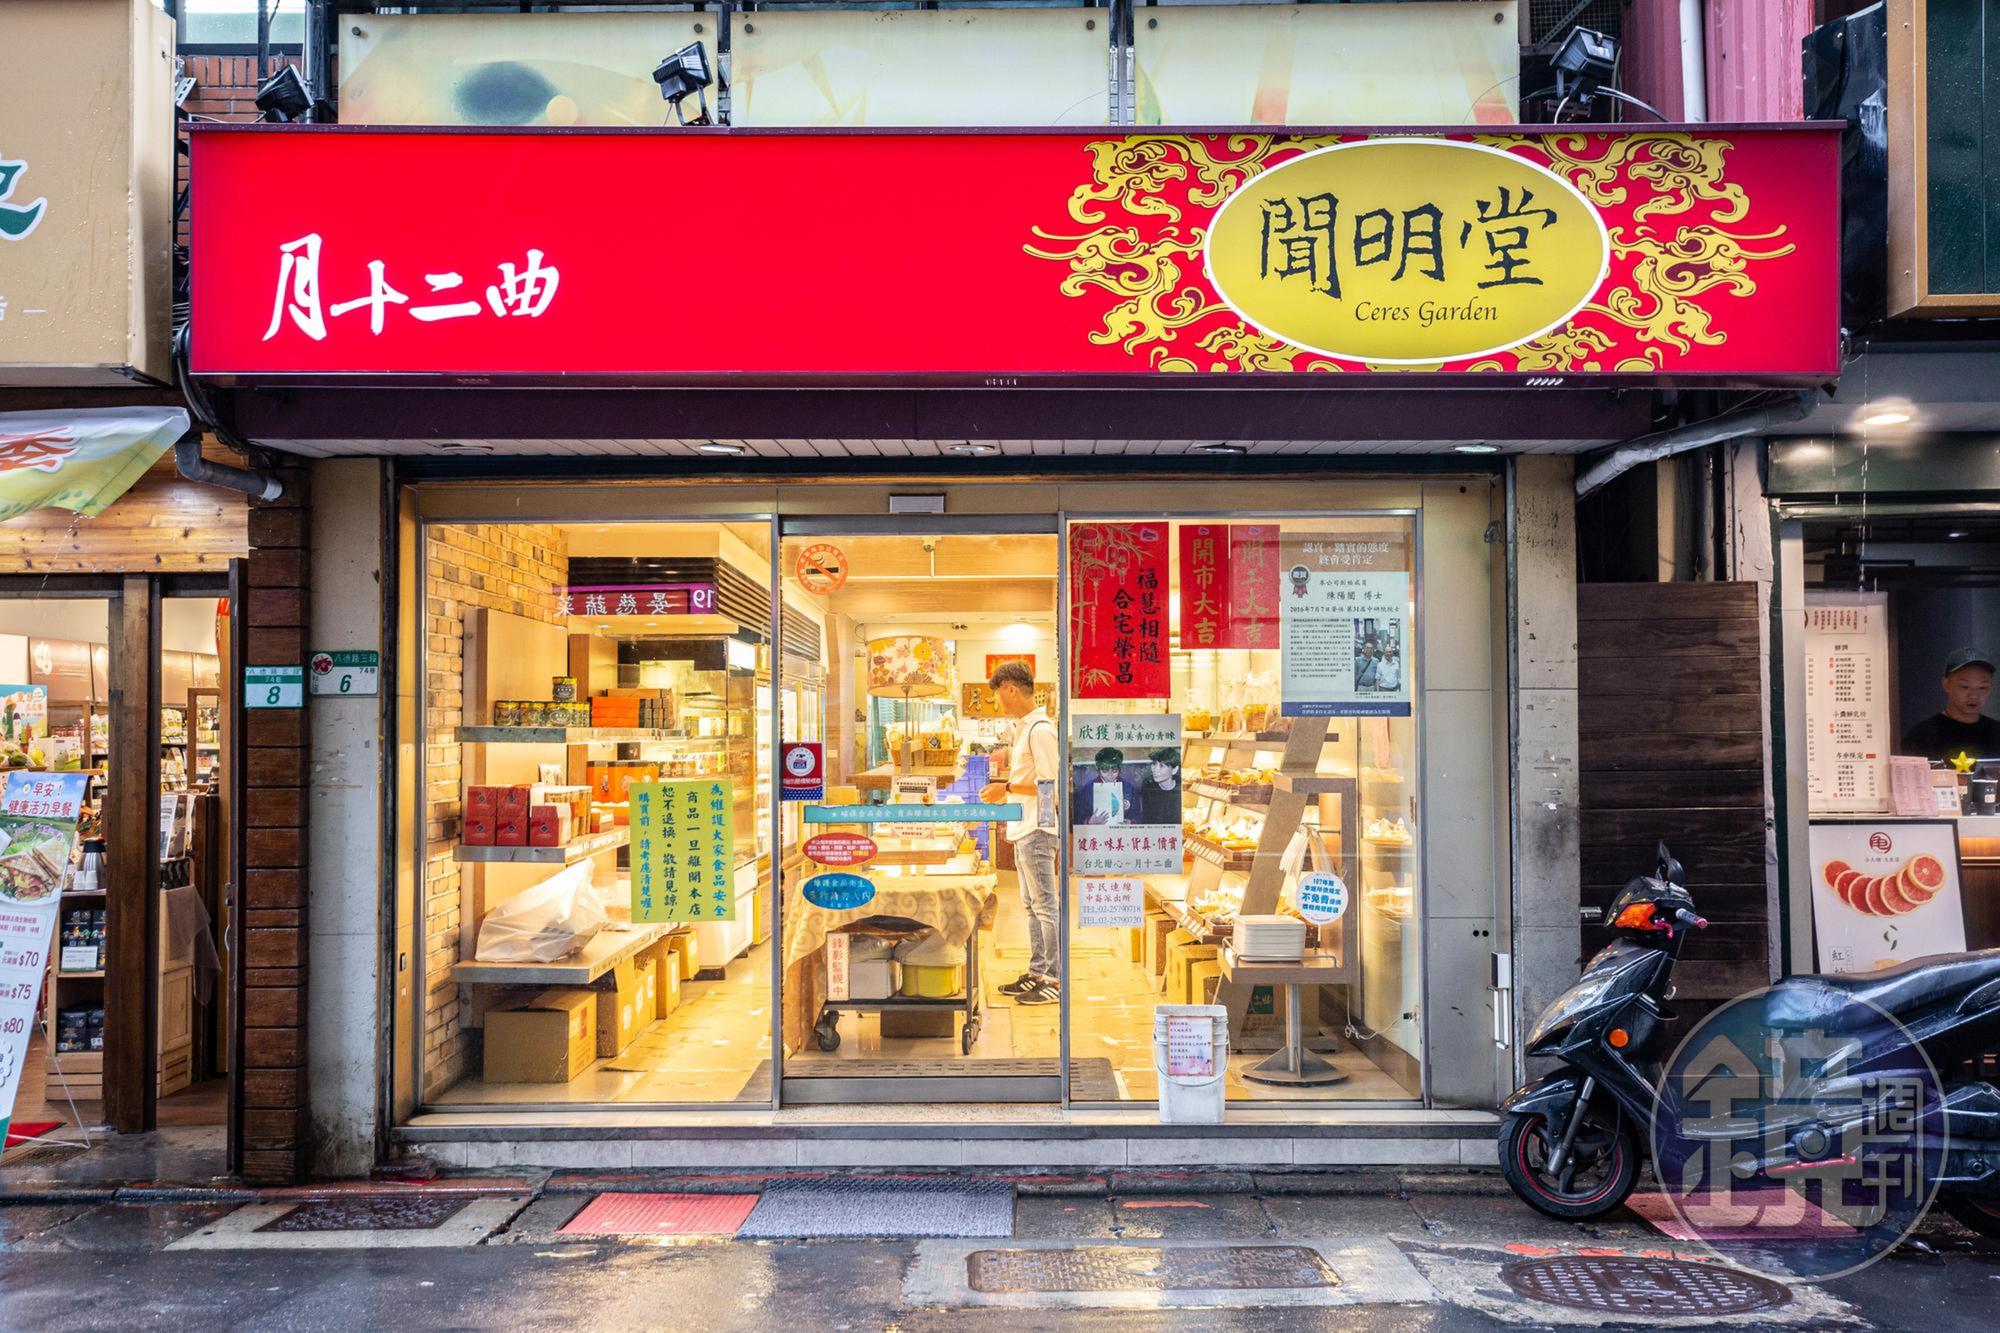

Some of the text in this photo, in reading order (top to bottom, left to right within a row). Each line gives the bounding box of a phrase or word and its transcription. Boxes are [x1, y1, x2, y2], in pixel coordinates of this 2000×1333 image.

[1259, 186, 1558, 300] 聞明堂
[261, 232, 560, 341] 月十二曲
[1354, 300, 1499, 327] Ceres Garden
[1191, 537, 1219, 645] 開市大吉
[1237, 536, 1269, 644] 開工大吉
[1136, 568, 1162, 665] 福慧相隨
[340, 674, 352, 693] 6
[266, 685, 281, 705] 8
[1079, 723, 1110, 741] 欣獲
[8, 799, 72, 816] 健康活力早餐
[686, 791, 702, 916] 商品一旦離開本店
[1086, 882, 1133, 892] 警民連線
[18, 951, 39, 968] $70
[11, 983, 32, 1000] $75
[3, 1018, 24, 1034] $80
